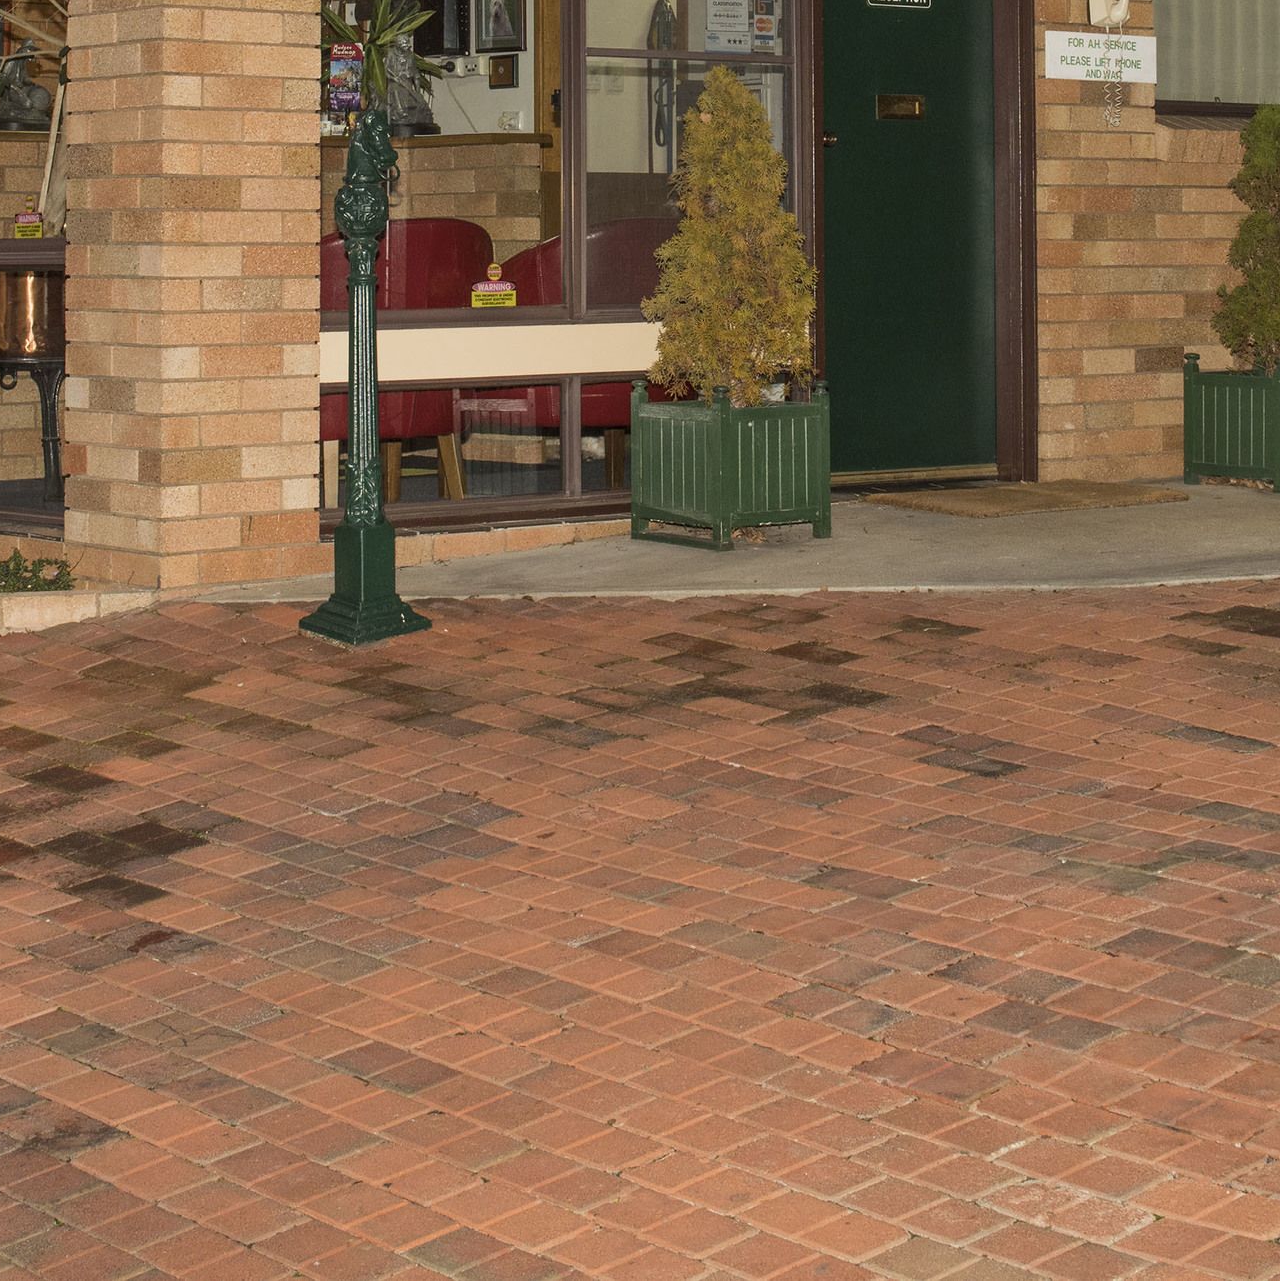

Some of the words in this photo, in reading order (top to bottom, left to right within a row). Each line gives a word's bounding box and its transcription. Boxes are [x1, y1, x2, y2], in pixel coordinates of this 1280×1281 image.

[1067, 37, 1085, 48] FOR
[1103, 39, 1137, 52] SERVICE
[1060, 55, 1091, 67] PLEASE
[1085, 69, 1102, 80] AND
[478, 283, 511, 291] WARNING
